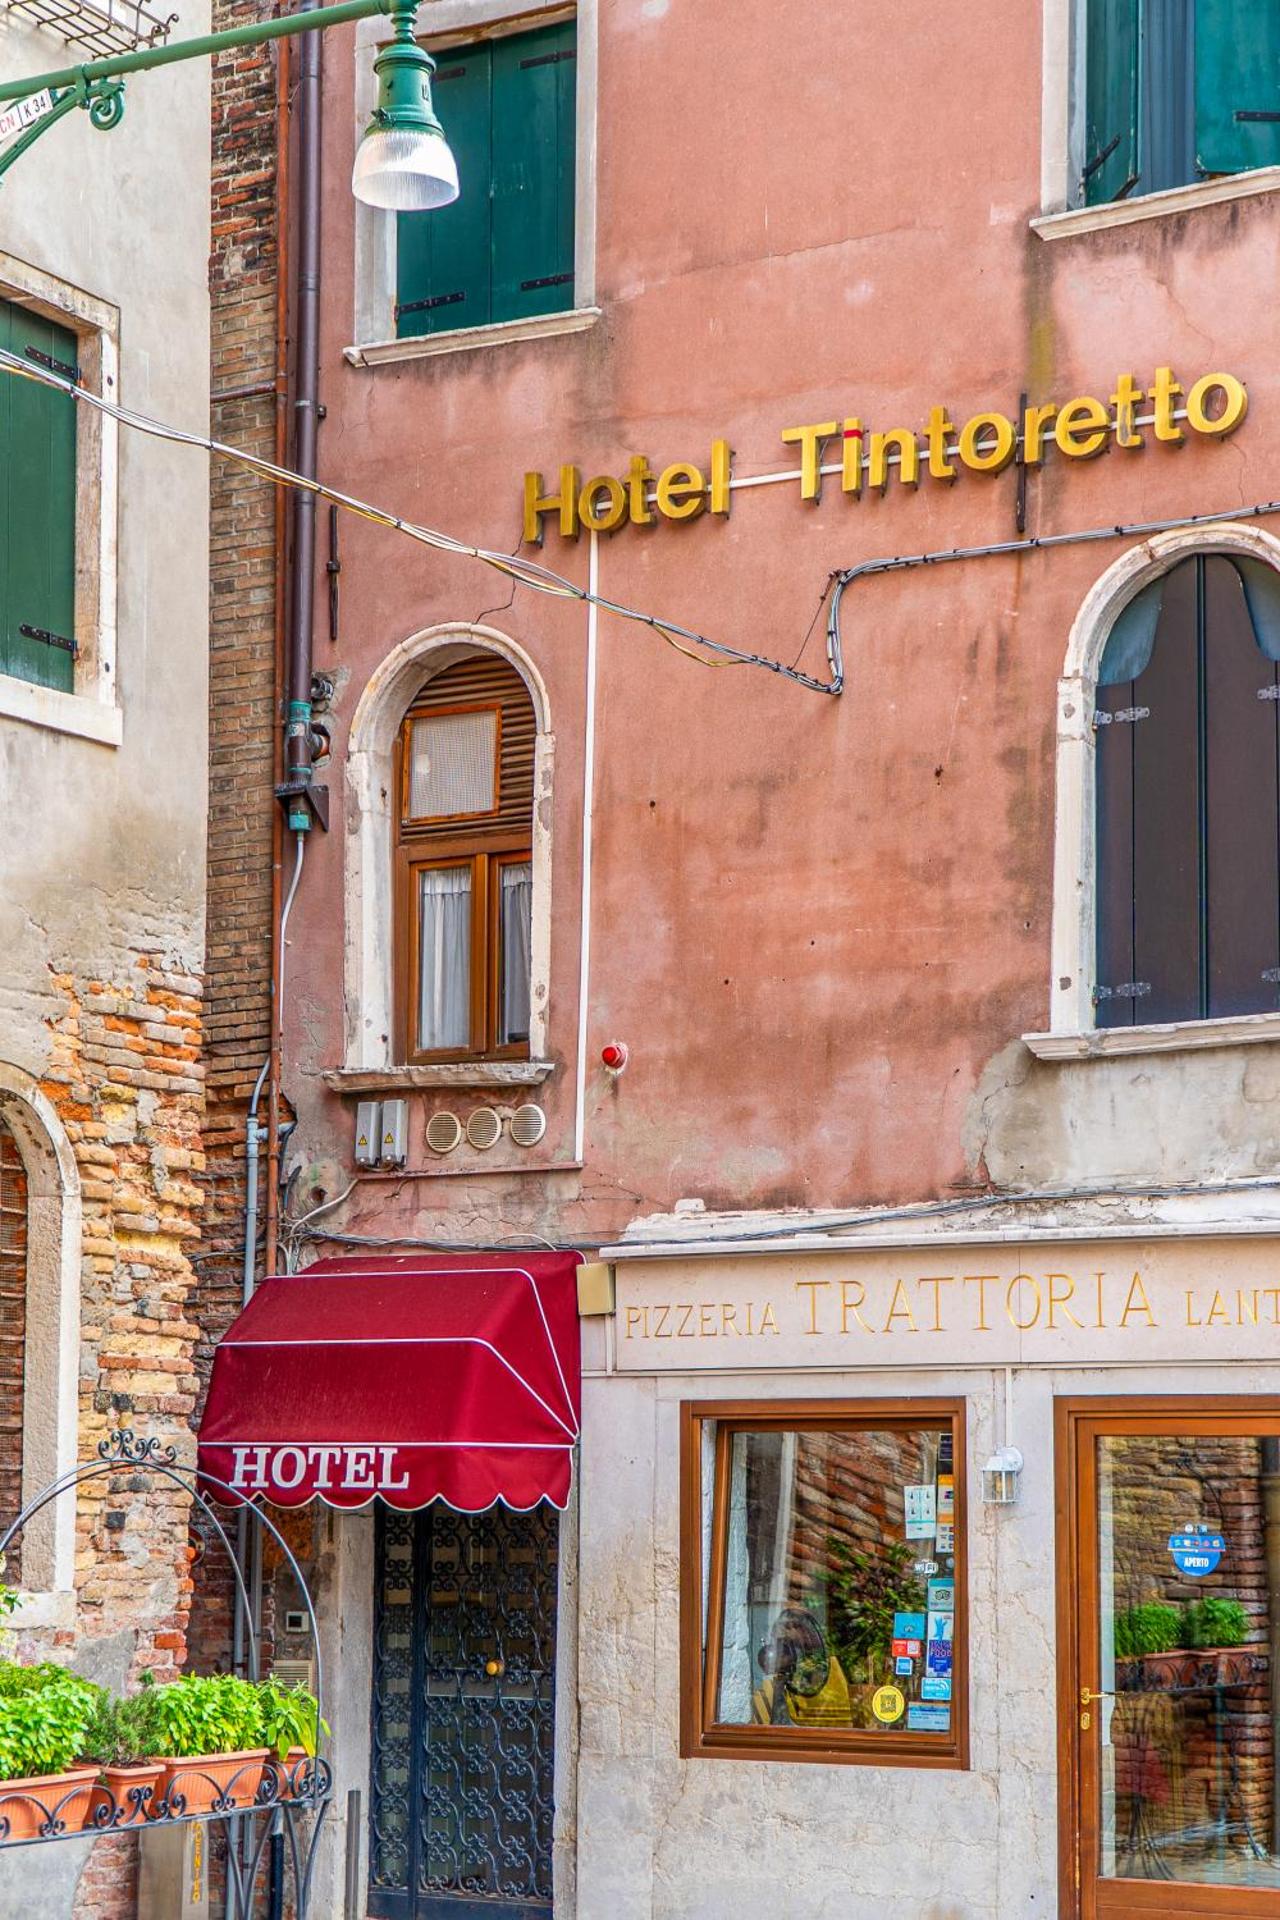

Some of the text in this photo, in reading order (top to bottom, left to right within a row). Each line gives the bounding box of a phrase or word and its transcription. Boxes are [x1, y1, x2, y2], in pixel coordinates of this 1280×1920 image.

[23, 103, 32, 119] K
[33, 95, 46, 113] 34
[524, 366, 1248, 546] Hotel Tintoretto
[624, 1271, 1280, 1339] PIZZERIA TRATTORIA LANT
[228, 1447, 410, 1489] HOTEL
[1183, 1557, 1209, 1568] APERTO
